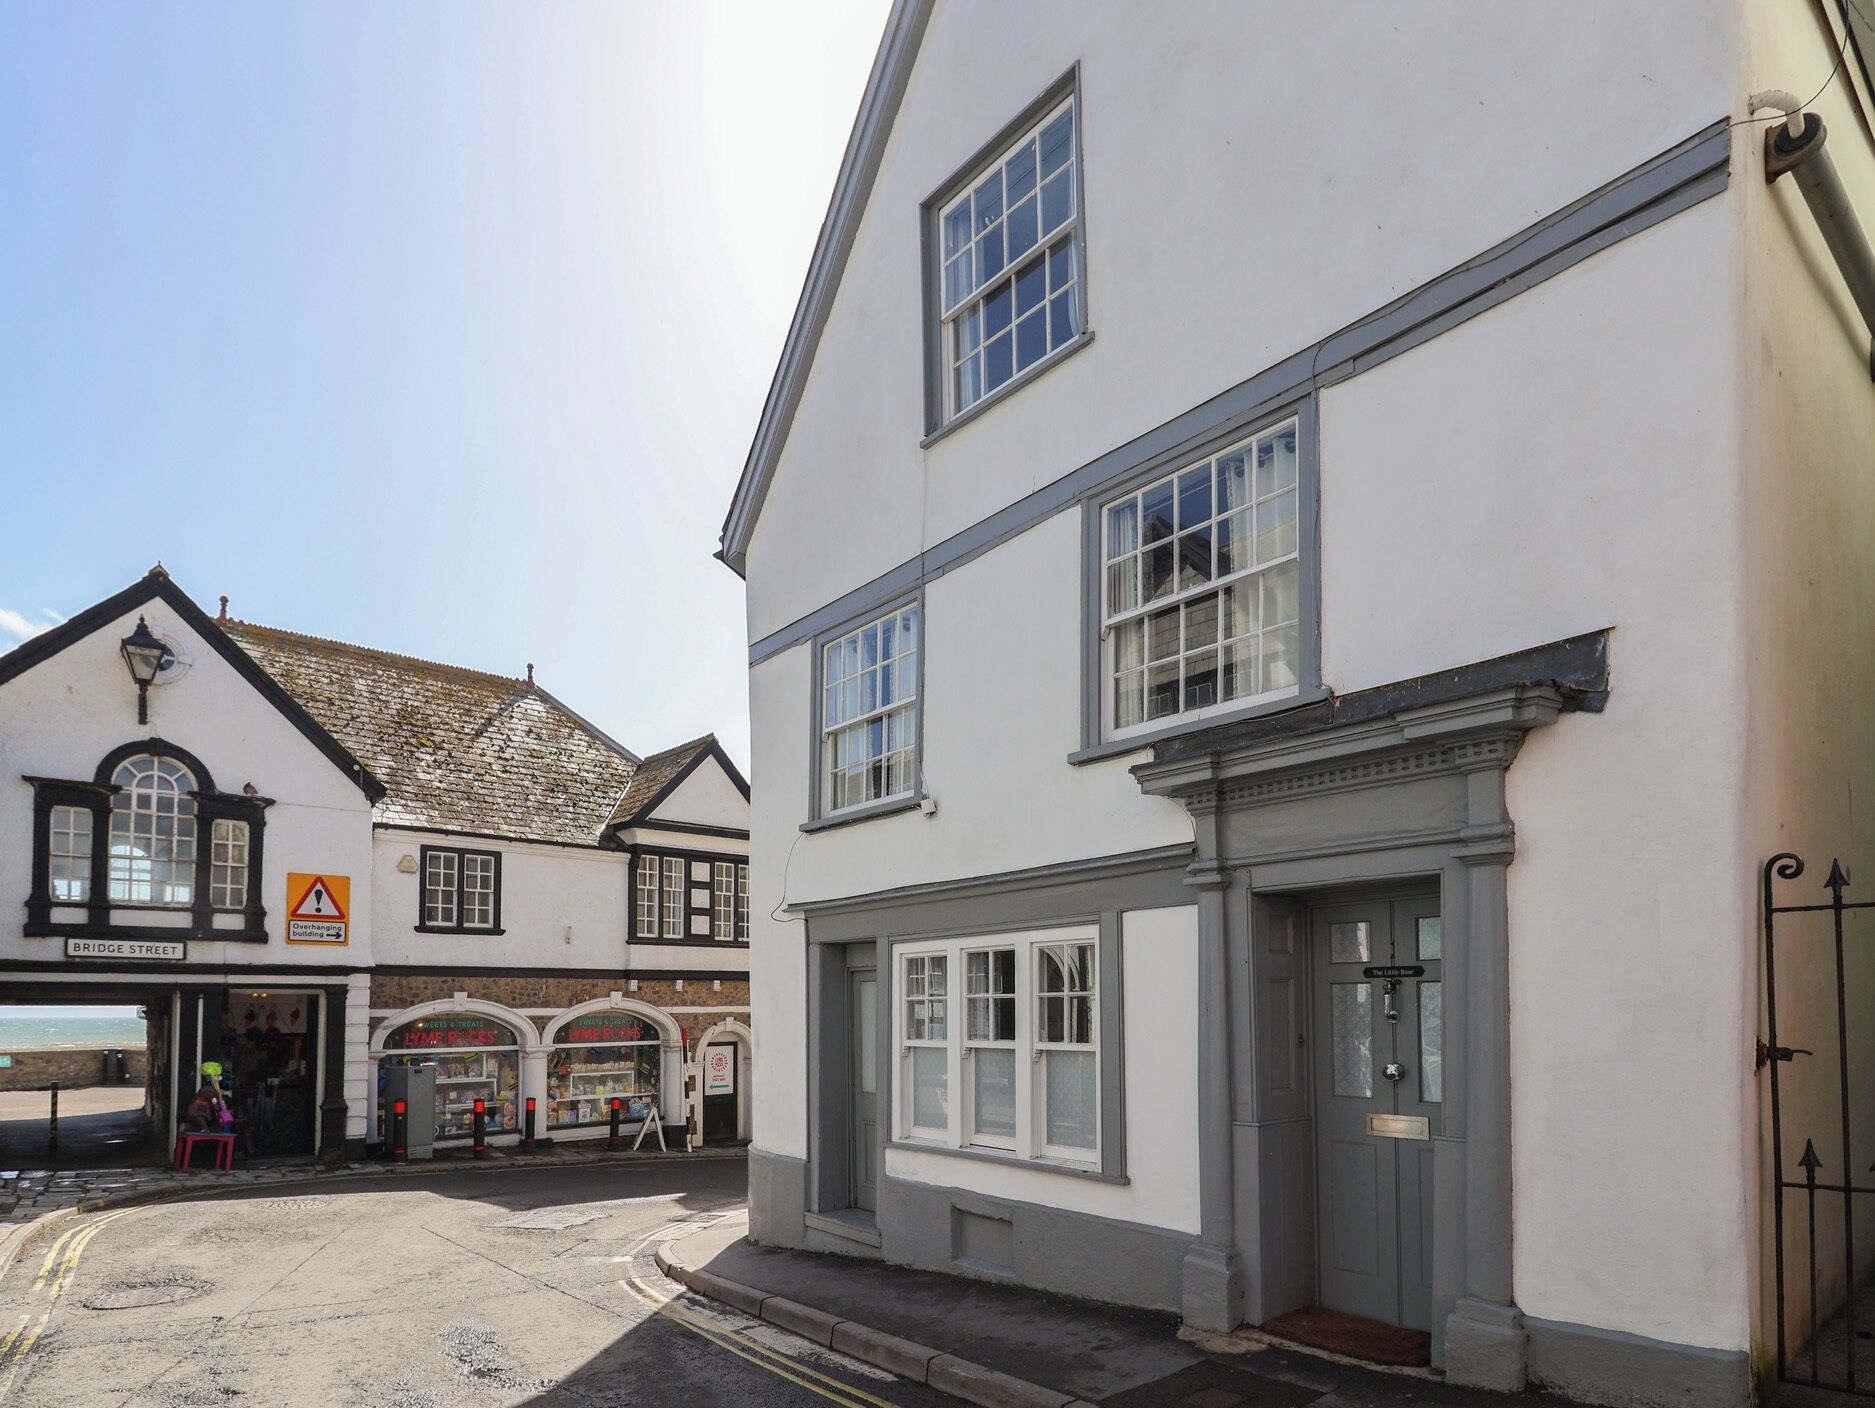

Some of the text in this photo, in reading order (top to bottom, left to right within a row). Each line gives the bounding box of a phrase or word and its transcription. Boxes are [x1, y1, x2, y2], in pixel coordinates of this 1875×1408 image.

[293, 923, 342, 932] Overhanging
[73, 943, 178, 955] BRIDGE STREET
[405, 1031, 443, 1045] LYME
[568, 1028, 599, 1041] LYME
